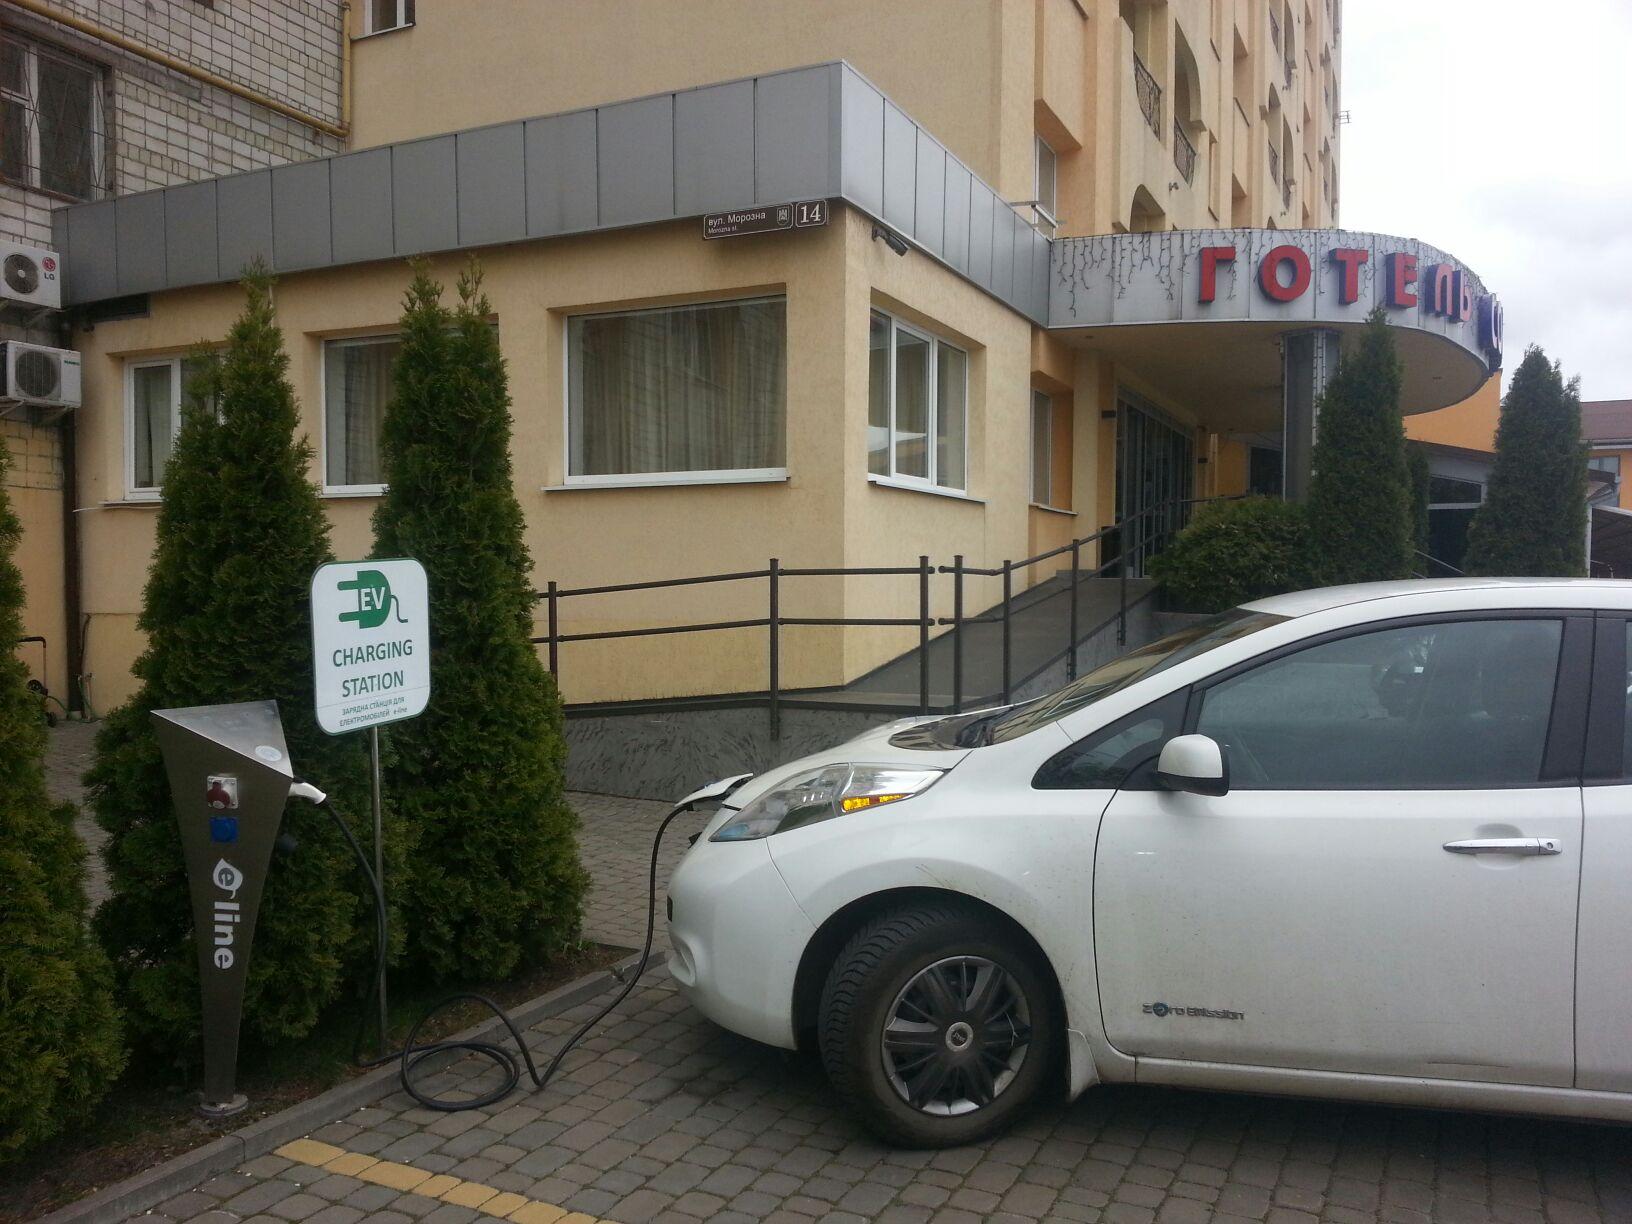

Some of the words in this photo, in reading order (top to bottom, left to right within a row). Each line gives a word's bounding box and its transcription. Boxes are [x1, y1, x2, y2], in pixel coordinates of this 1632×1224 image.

[708, 218, 726, 228] вул.
[727, 211, 766, 224] Морозна
[800, 203, 821, 223] 14
[44, 273, 55, 281] LG
[1199, 245, 1473, 323] ГОТЕЛЬ
[360, 586, 386, 611] EV
[332, 639, 413, 667] CHARGING
[342, 670, 404, 698] STATION
[342, 704, 369, 716] ЗАРЯДНА
[393, 696, 405, 705] ДЛЯ
